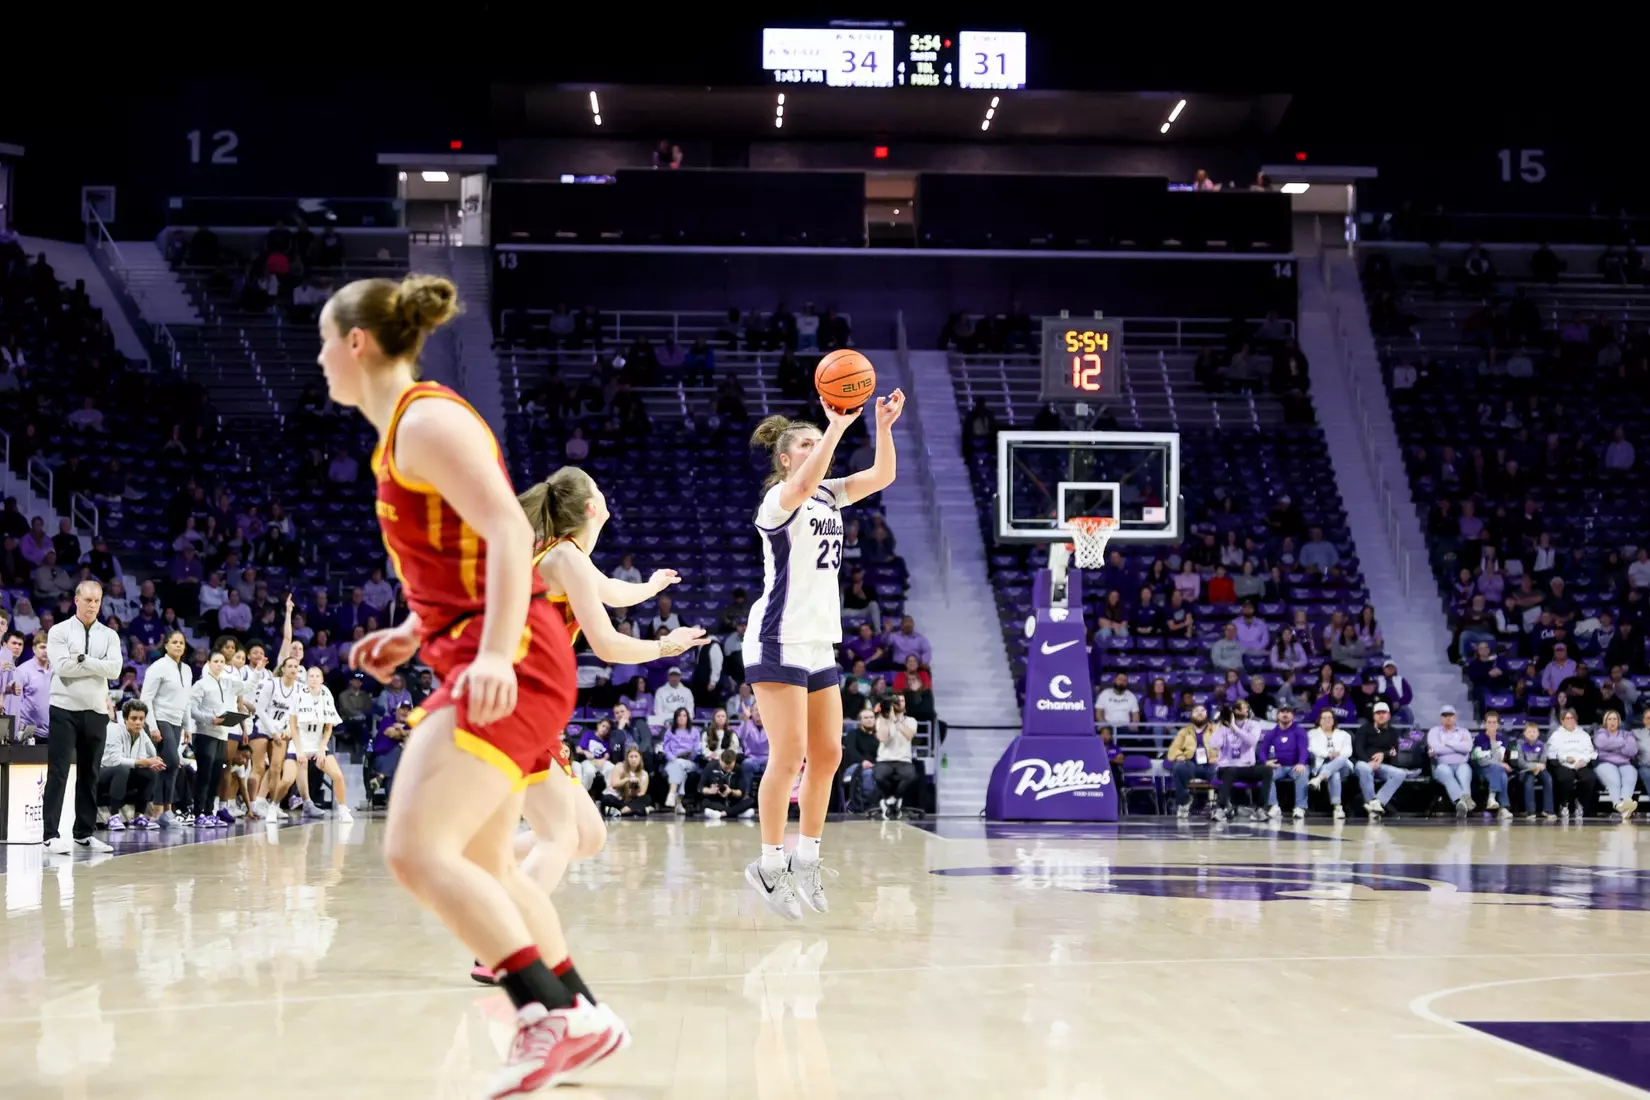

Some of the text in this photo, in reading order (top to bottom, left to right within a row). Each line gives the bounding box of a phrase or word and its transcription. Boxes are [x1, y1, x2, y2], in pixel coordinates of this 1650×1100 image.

[910, 35, 941, 51] 5:54
[842, 50, 878, 74] 34
[897, 62, 905, 73] 4
[944, 62, 952, 74] 4
[974, 52, 1006, 75] 31
[774, 69, 823, 82] 1:43 PM
[898, 74, 905, 85] 1
[944, 74, 952, 86] 4
[187, 129, 239, 165] 12
[1497, 148, 1547, 184] 15
[498, 252, 518, 270] 13
[1272, 261, 1292, 280] 14
[1065, 330, 1108, 353] 5:54
[1073, 354, 1101, 391] 12
[842, 378, 872, 393] ELITE
[810, 517, 844, 536] Wildca
[816, 539, 841, 570] 23
[272, 710, 285, 721] 10
[307, 724, 317, 732] 11
[1010, 757, 1111, 799] Dillons
